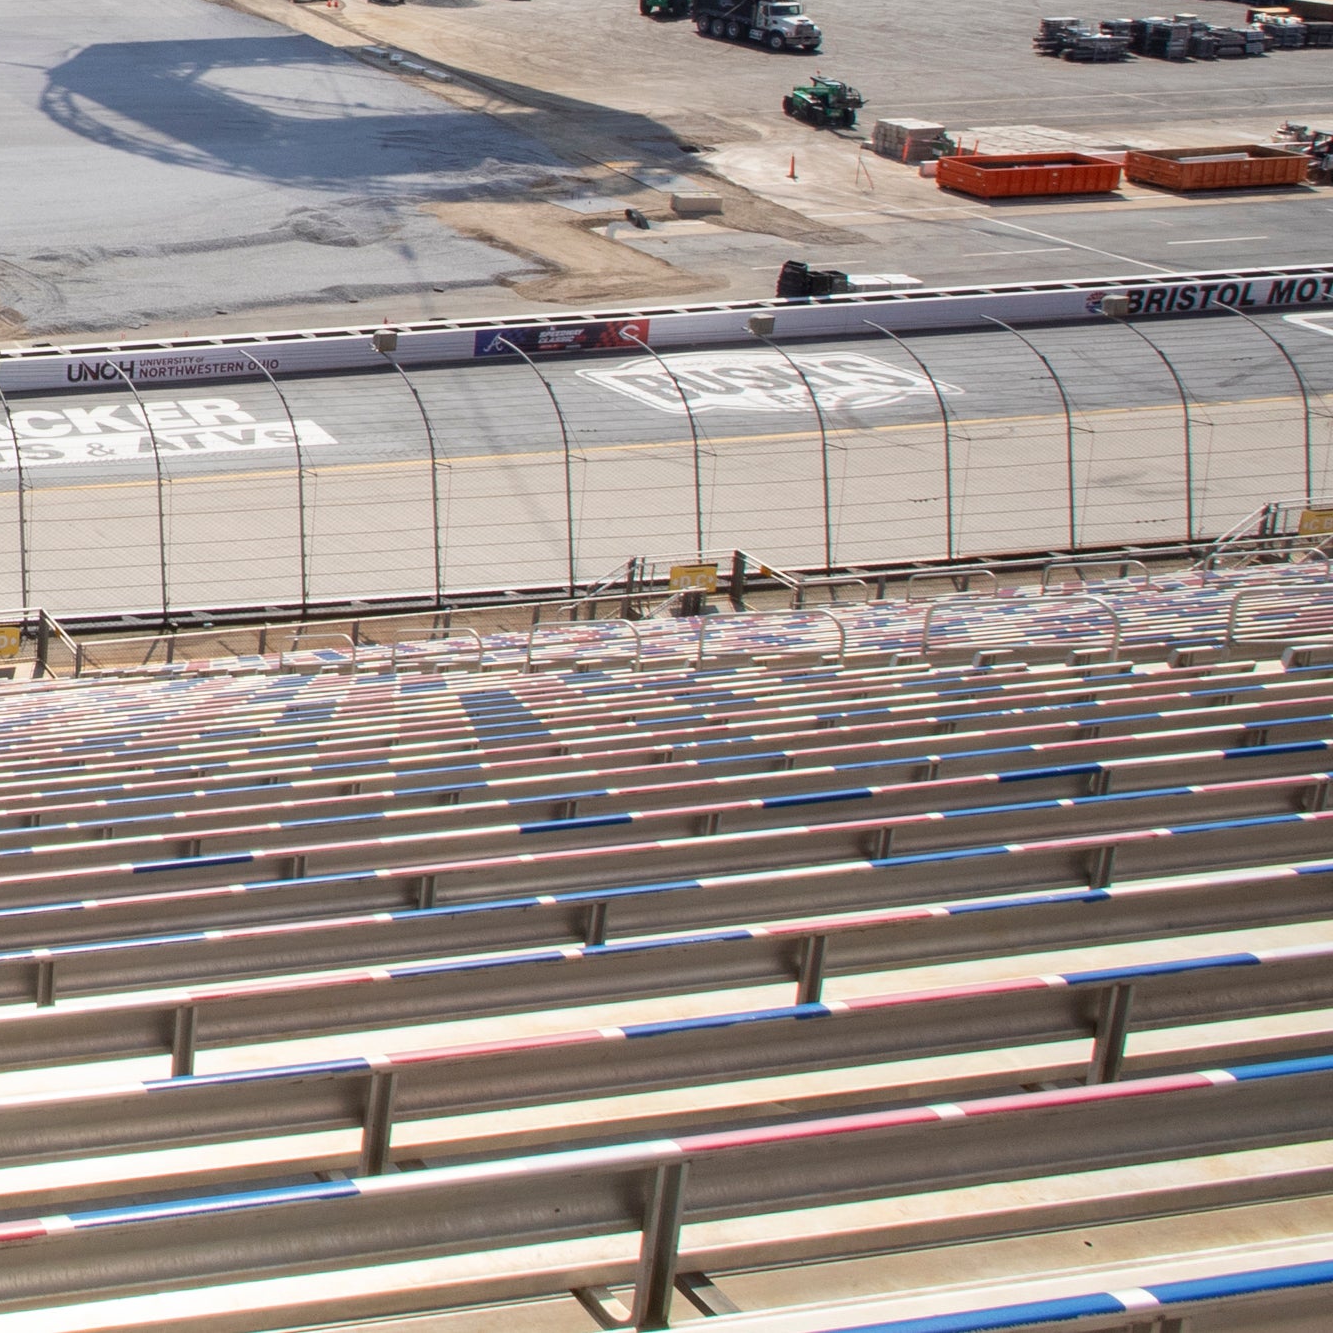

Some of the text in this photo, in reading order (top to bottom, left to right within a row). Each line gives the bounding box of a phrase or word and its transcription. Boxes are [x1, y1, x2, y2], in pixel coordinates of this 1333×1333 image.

[1126, 282, 1255, 314] BRISTOL
[537, 336, 575, 344] CLASSIC
[538, 329, 585, 338] SPEEDWAY
[618, 324, 641, 341] C
[139, 356, 194, 367] UNIVERSITY
[139, 359, 279, 379] NORTHWESTERN OHIO
[67, 359, 135, 383] UNOH
[610, 359, 916, 404] BUSH'S
[85, 442, 117, 459] &
